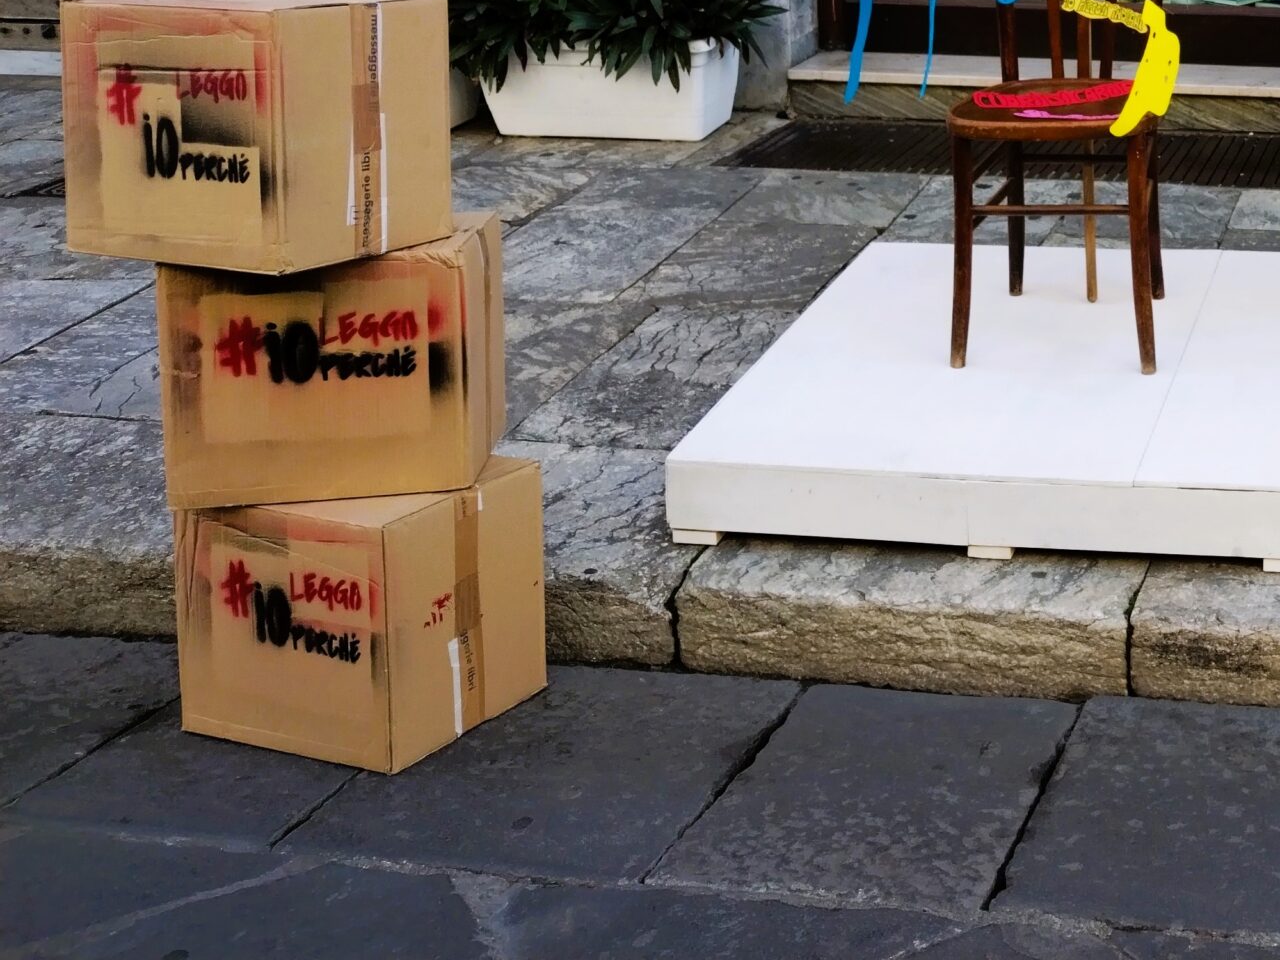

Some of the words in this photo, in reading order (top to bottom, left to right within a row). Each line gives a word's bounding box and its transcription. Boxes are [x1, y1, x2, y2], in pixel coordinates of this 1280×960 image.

[176, 68, 248, 104] LEGGO
[318, 310, 420, 348] LEGGO
[289, 571, 362, 611] LEGGO
